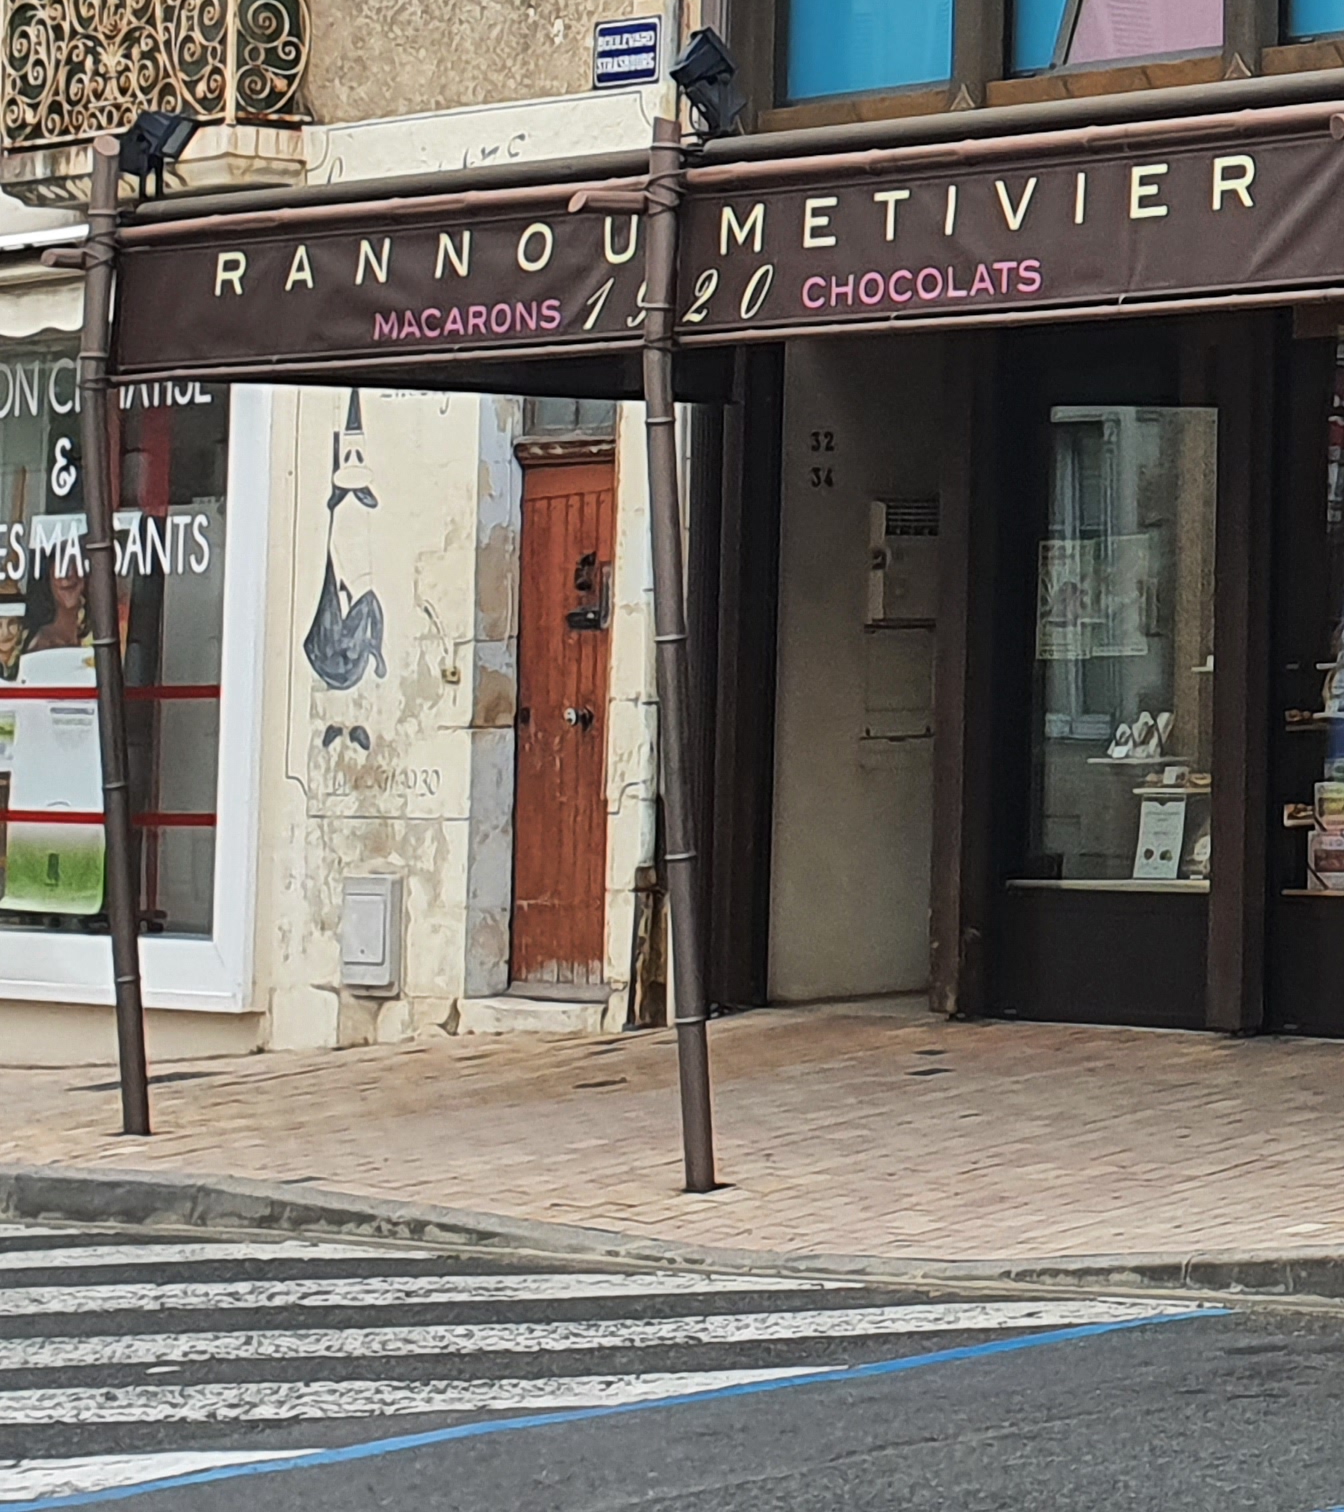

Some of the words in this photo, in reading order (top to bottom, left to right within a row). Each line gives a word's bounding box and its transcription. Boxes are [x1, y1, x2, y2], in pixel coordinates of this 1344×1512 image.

[214, 214, 639, 296] RANNOU
[720, 154, 1257, 256] METIVIER
[803, 259, 1042, 310] CHOCOLATS
[373, 299, 562, 341] MACARONS
[51, 437, 77, 497] &
[811, 431, 834, 452] 32
